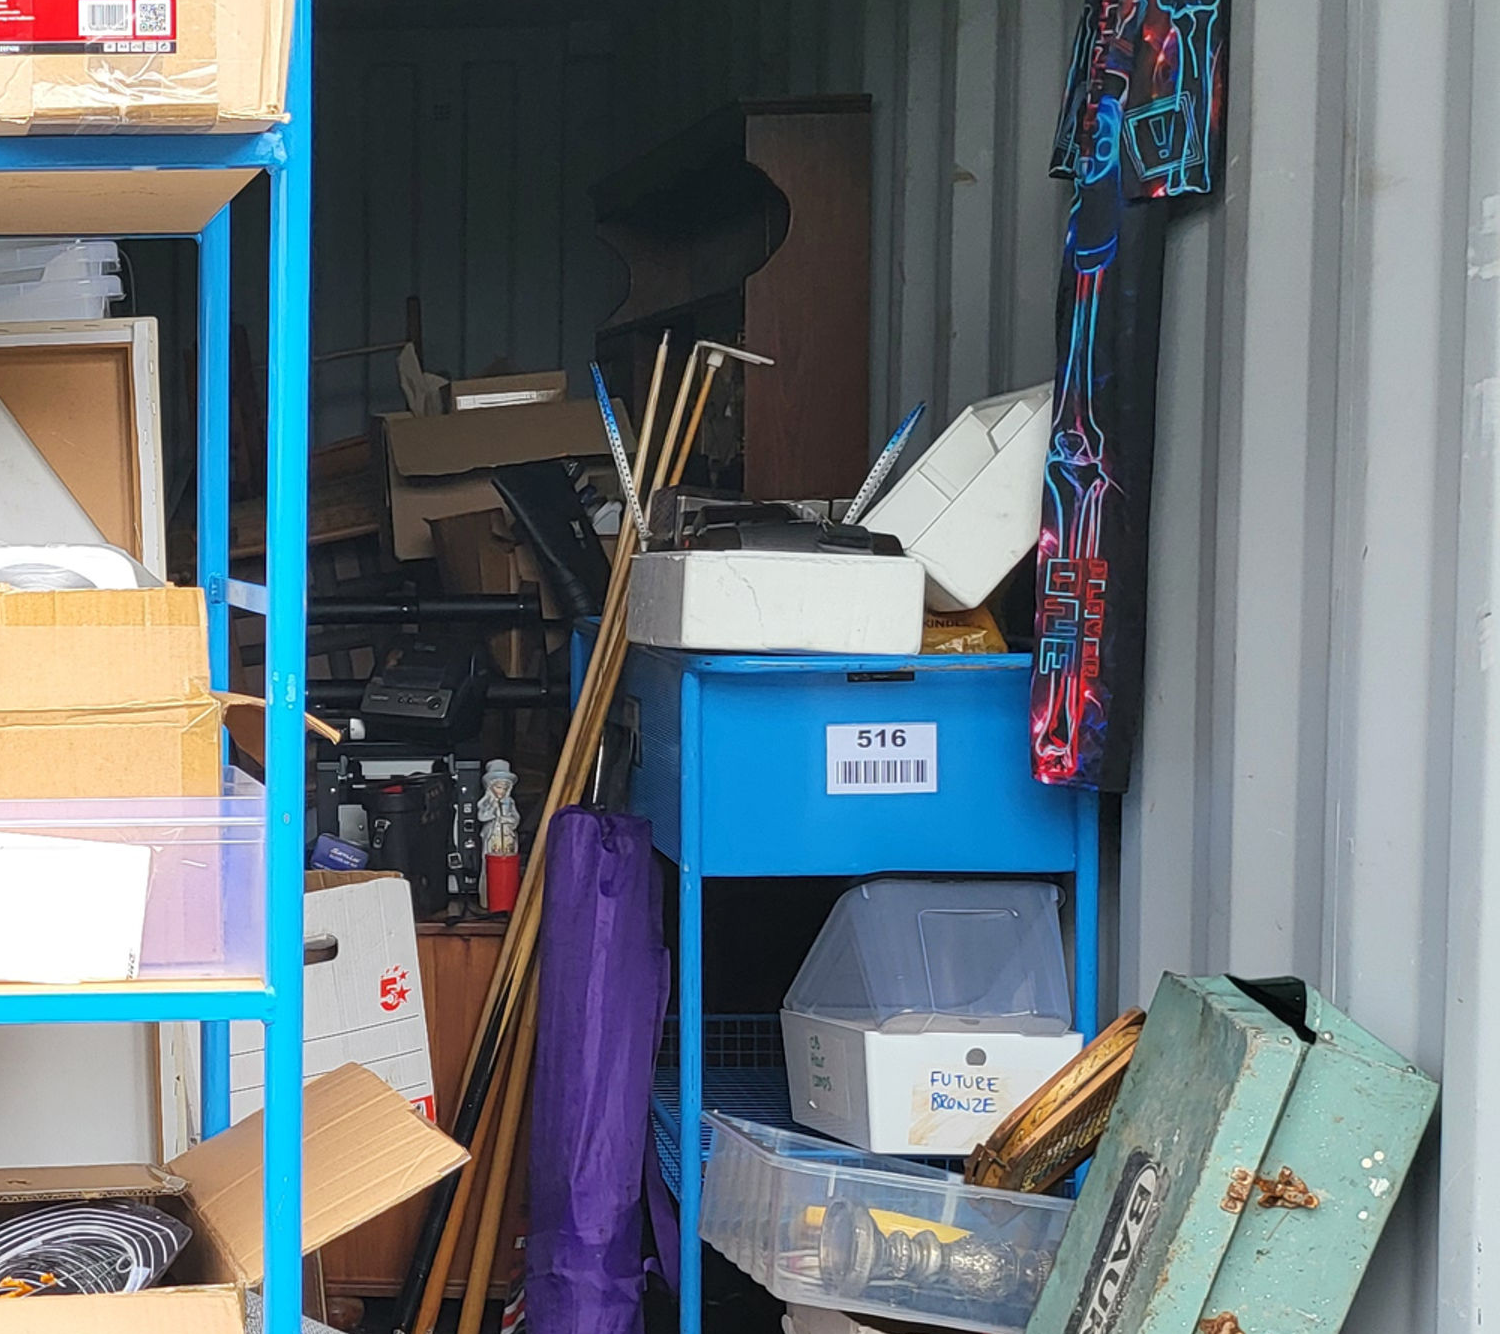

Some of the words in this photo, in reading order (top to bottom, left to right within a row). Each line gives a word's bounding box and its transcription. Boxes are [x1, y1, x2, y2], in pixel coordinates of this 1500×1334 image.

[857, 729, 906, 748] 516
[930, 1070, 999, 1092] FUTURE
[930, 1092, 998, 1113] BRONZE
